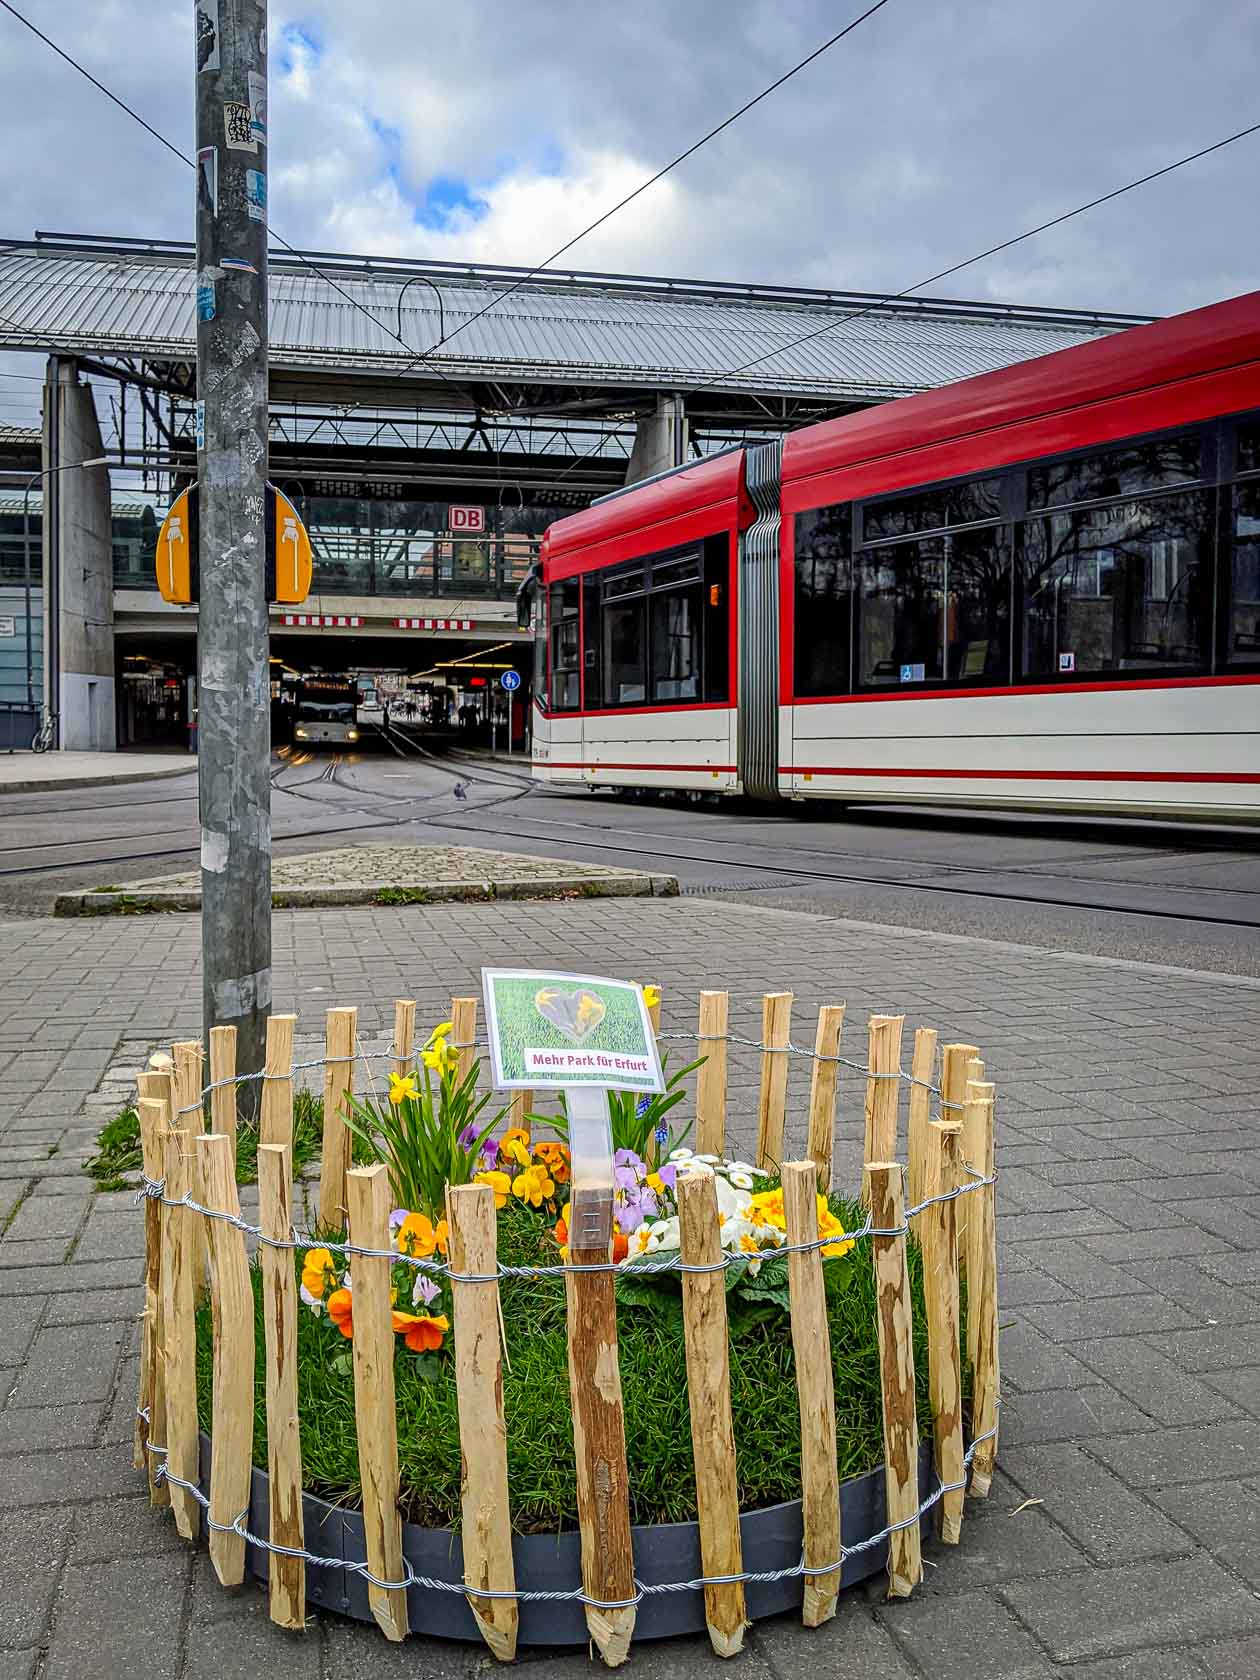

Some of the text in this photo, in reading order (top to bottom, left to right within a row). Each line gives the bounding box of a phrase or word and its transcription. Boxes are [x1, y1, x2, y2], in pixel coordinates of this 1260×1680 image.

[454, 510, 479, 527] DB
[533, 1054, 648, 1071] Mehr Park für Erfurt
